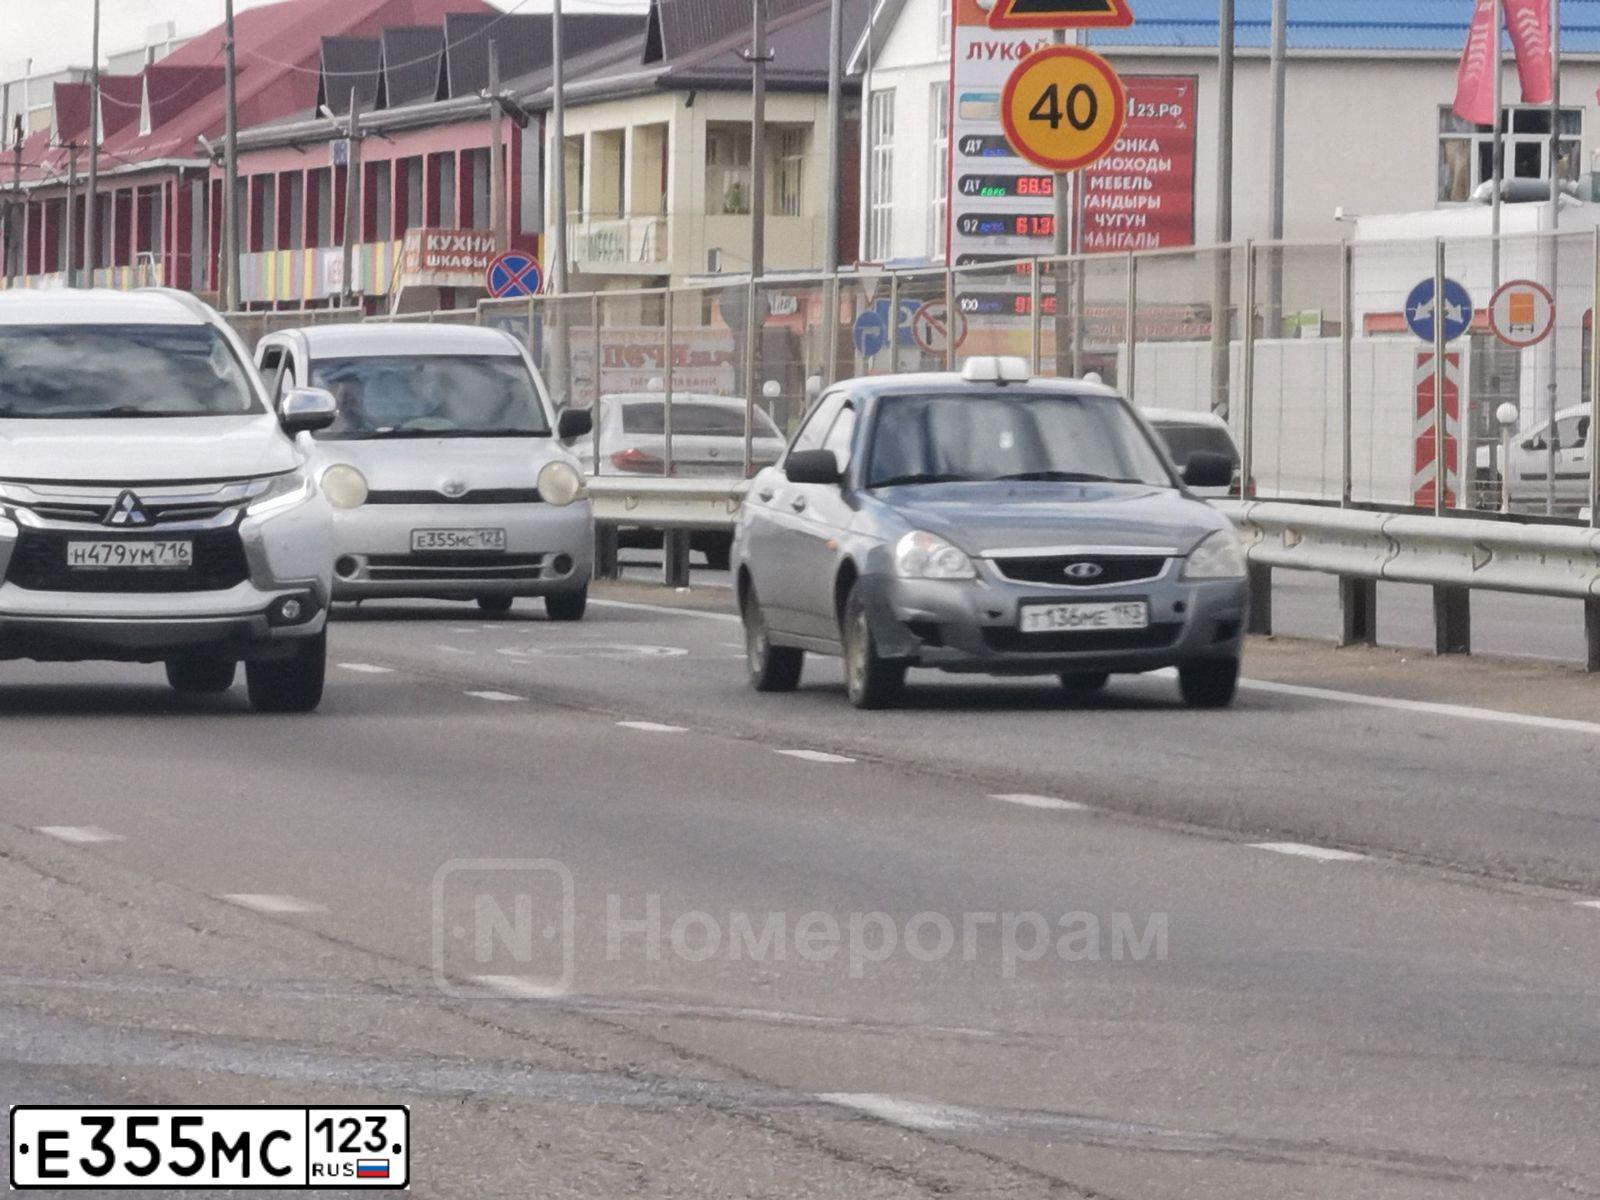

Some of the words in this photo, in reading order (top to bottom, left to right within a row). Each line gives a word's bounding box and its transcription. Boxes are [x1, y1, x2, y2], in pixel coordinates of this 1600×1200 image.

[1029, 83, 1098, 131] 40
[965, 139, 983, 154] ДТ
[1113, 138, 1160, 152] ОНКА
[964, 179, 982, 193] ДТ
[1091, 175, 1152, 190] МЕБЕЛЬ
[963, 219, 979, 232] 92
[1095, 213, 1146, 227] ЧУГУН
[427, 234, 496, 252] КУХНИ
[427, 254, 487, 268] ШКАФЫ
[961, 298, 979, 311] 100
[417, 532, 473, 547] Е355МС
[74, 544, 155, 564] Н479УМ
[156, 543, 189, 558] 716
